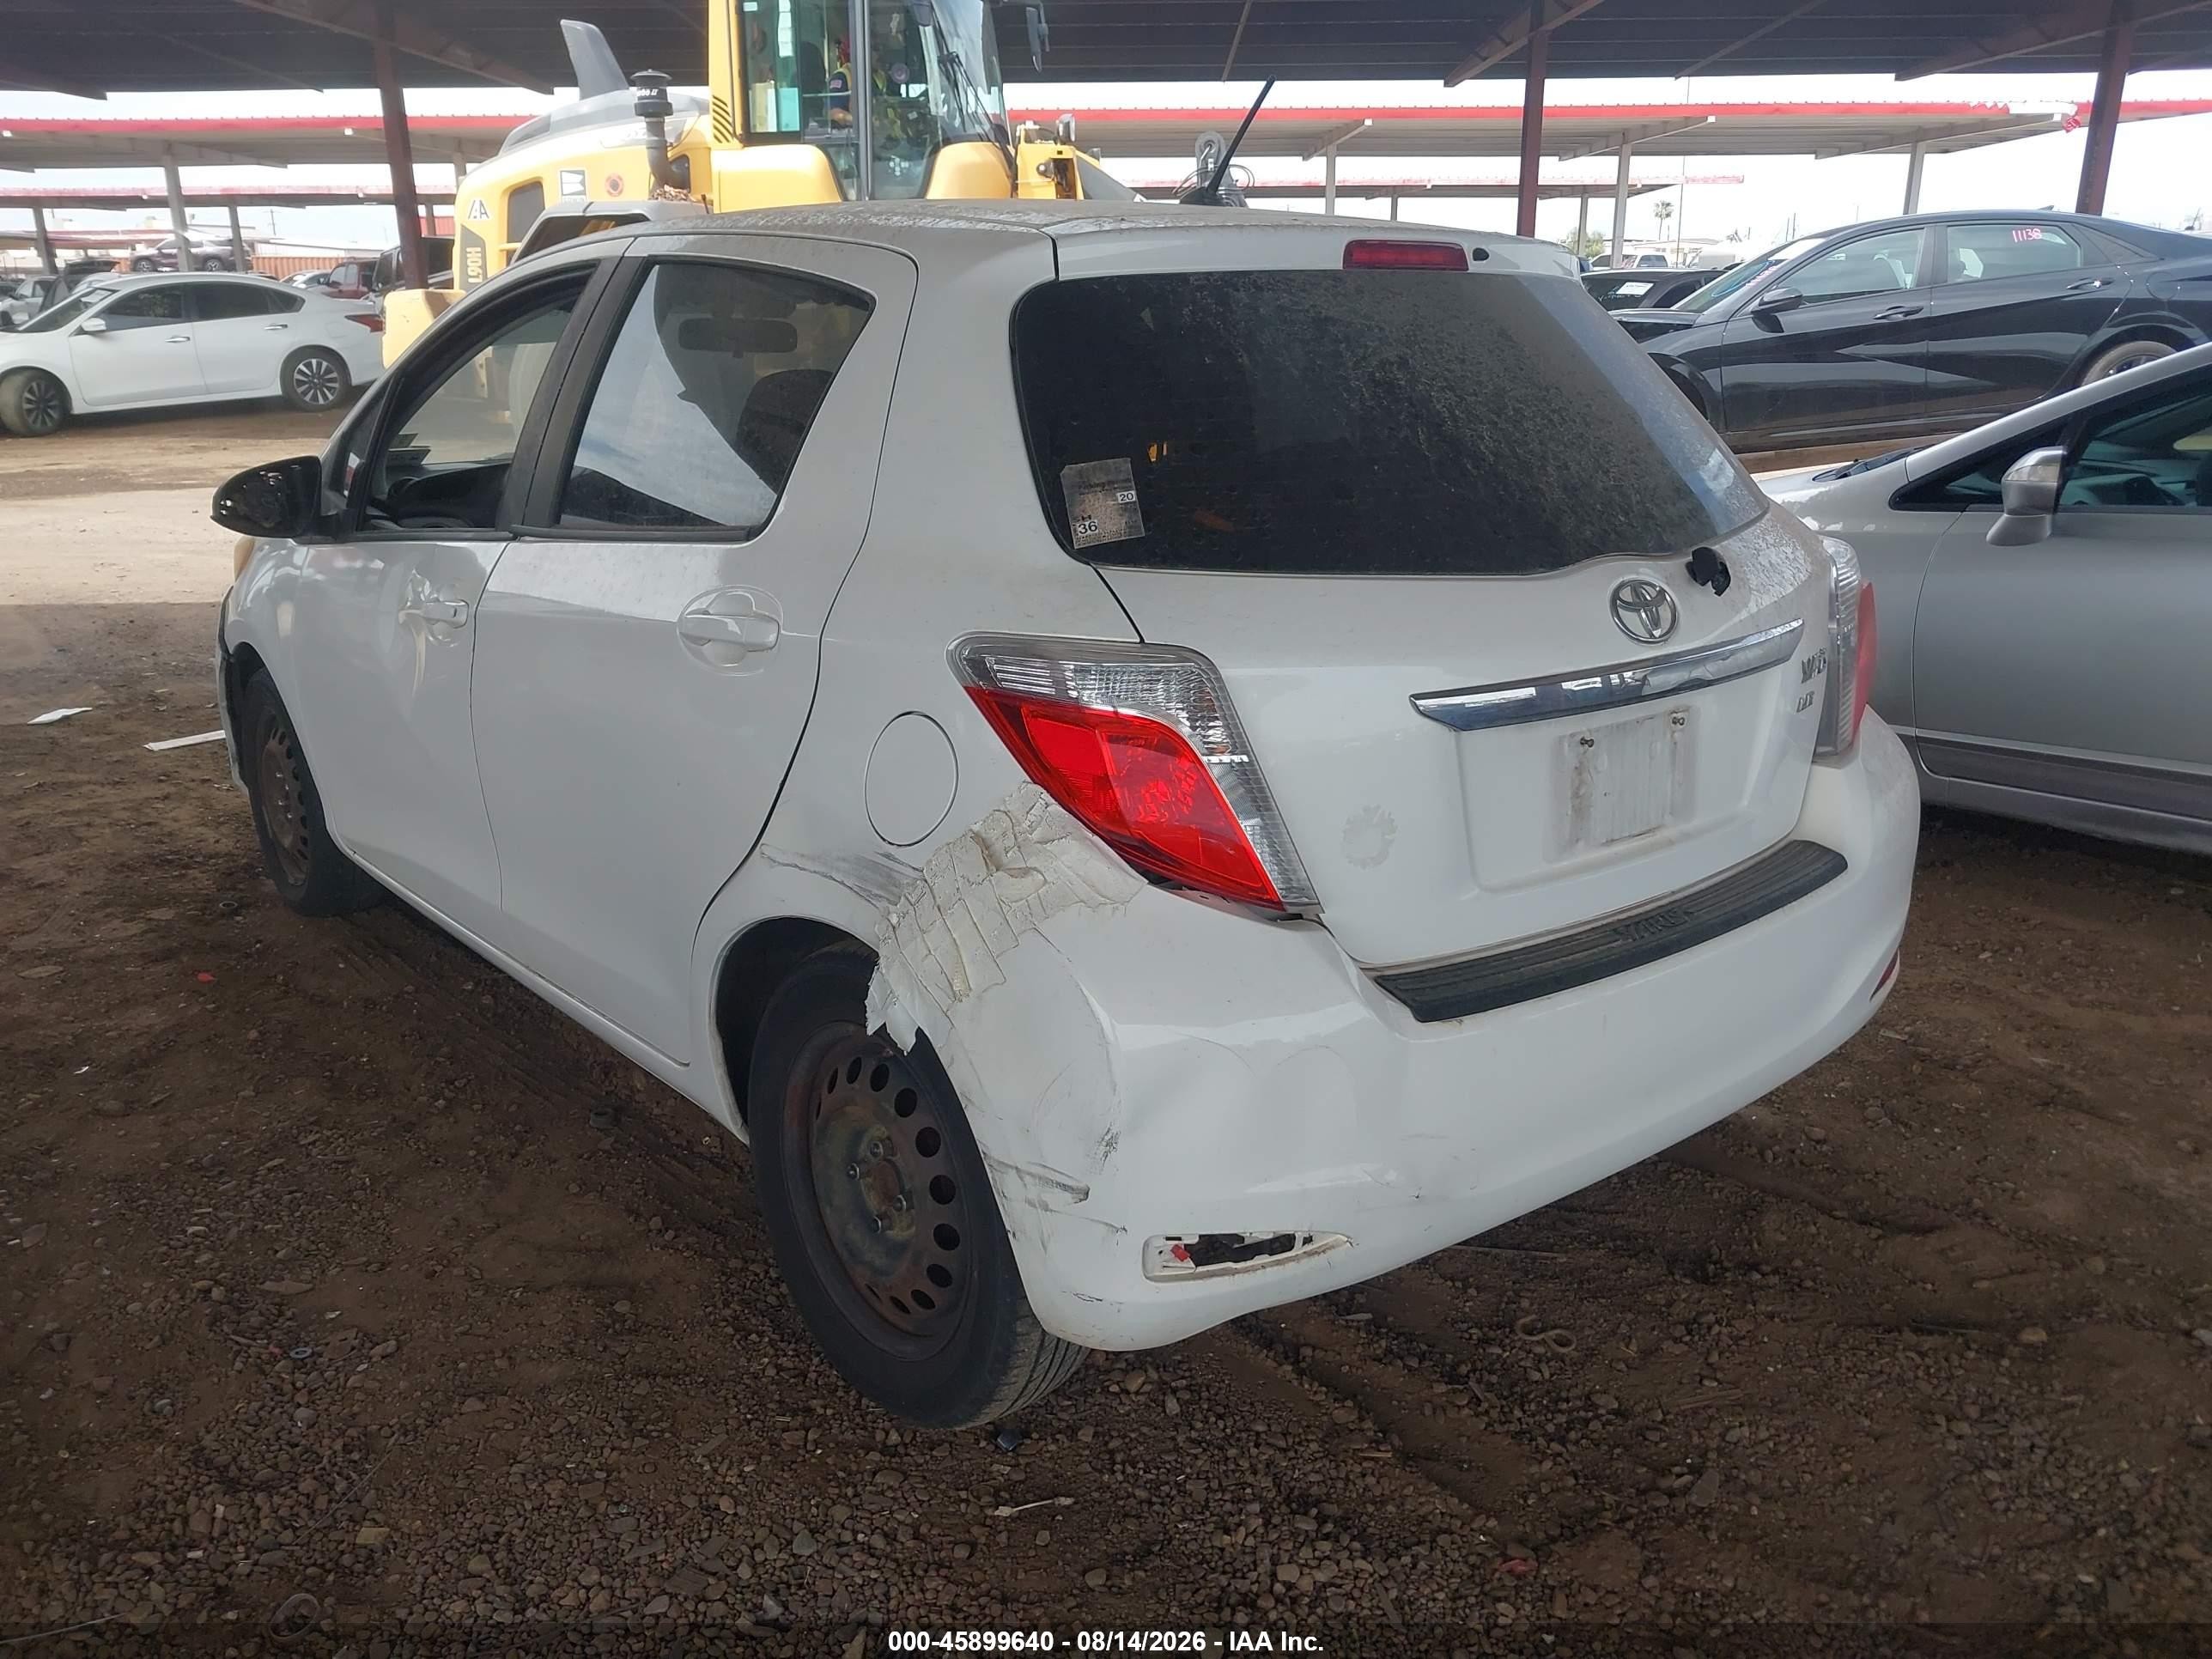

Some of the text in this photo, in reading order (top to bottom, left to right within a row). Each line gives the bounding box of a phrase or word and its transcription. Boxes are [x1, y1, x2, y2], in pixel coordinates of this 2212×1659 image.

[2012, 228, 2042, 243] 11138
[466, 246, 483, 283] L90H
[1119, 492, 1134, 501] 20
[1078, 520, 1098, 535] 36
